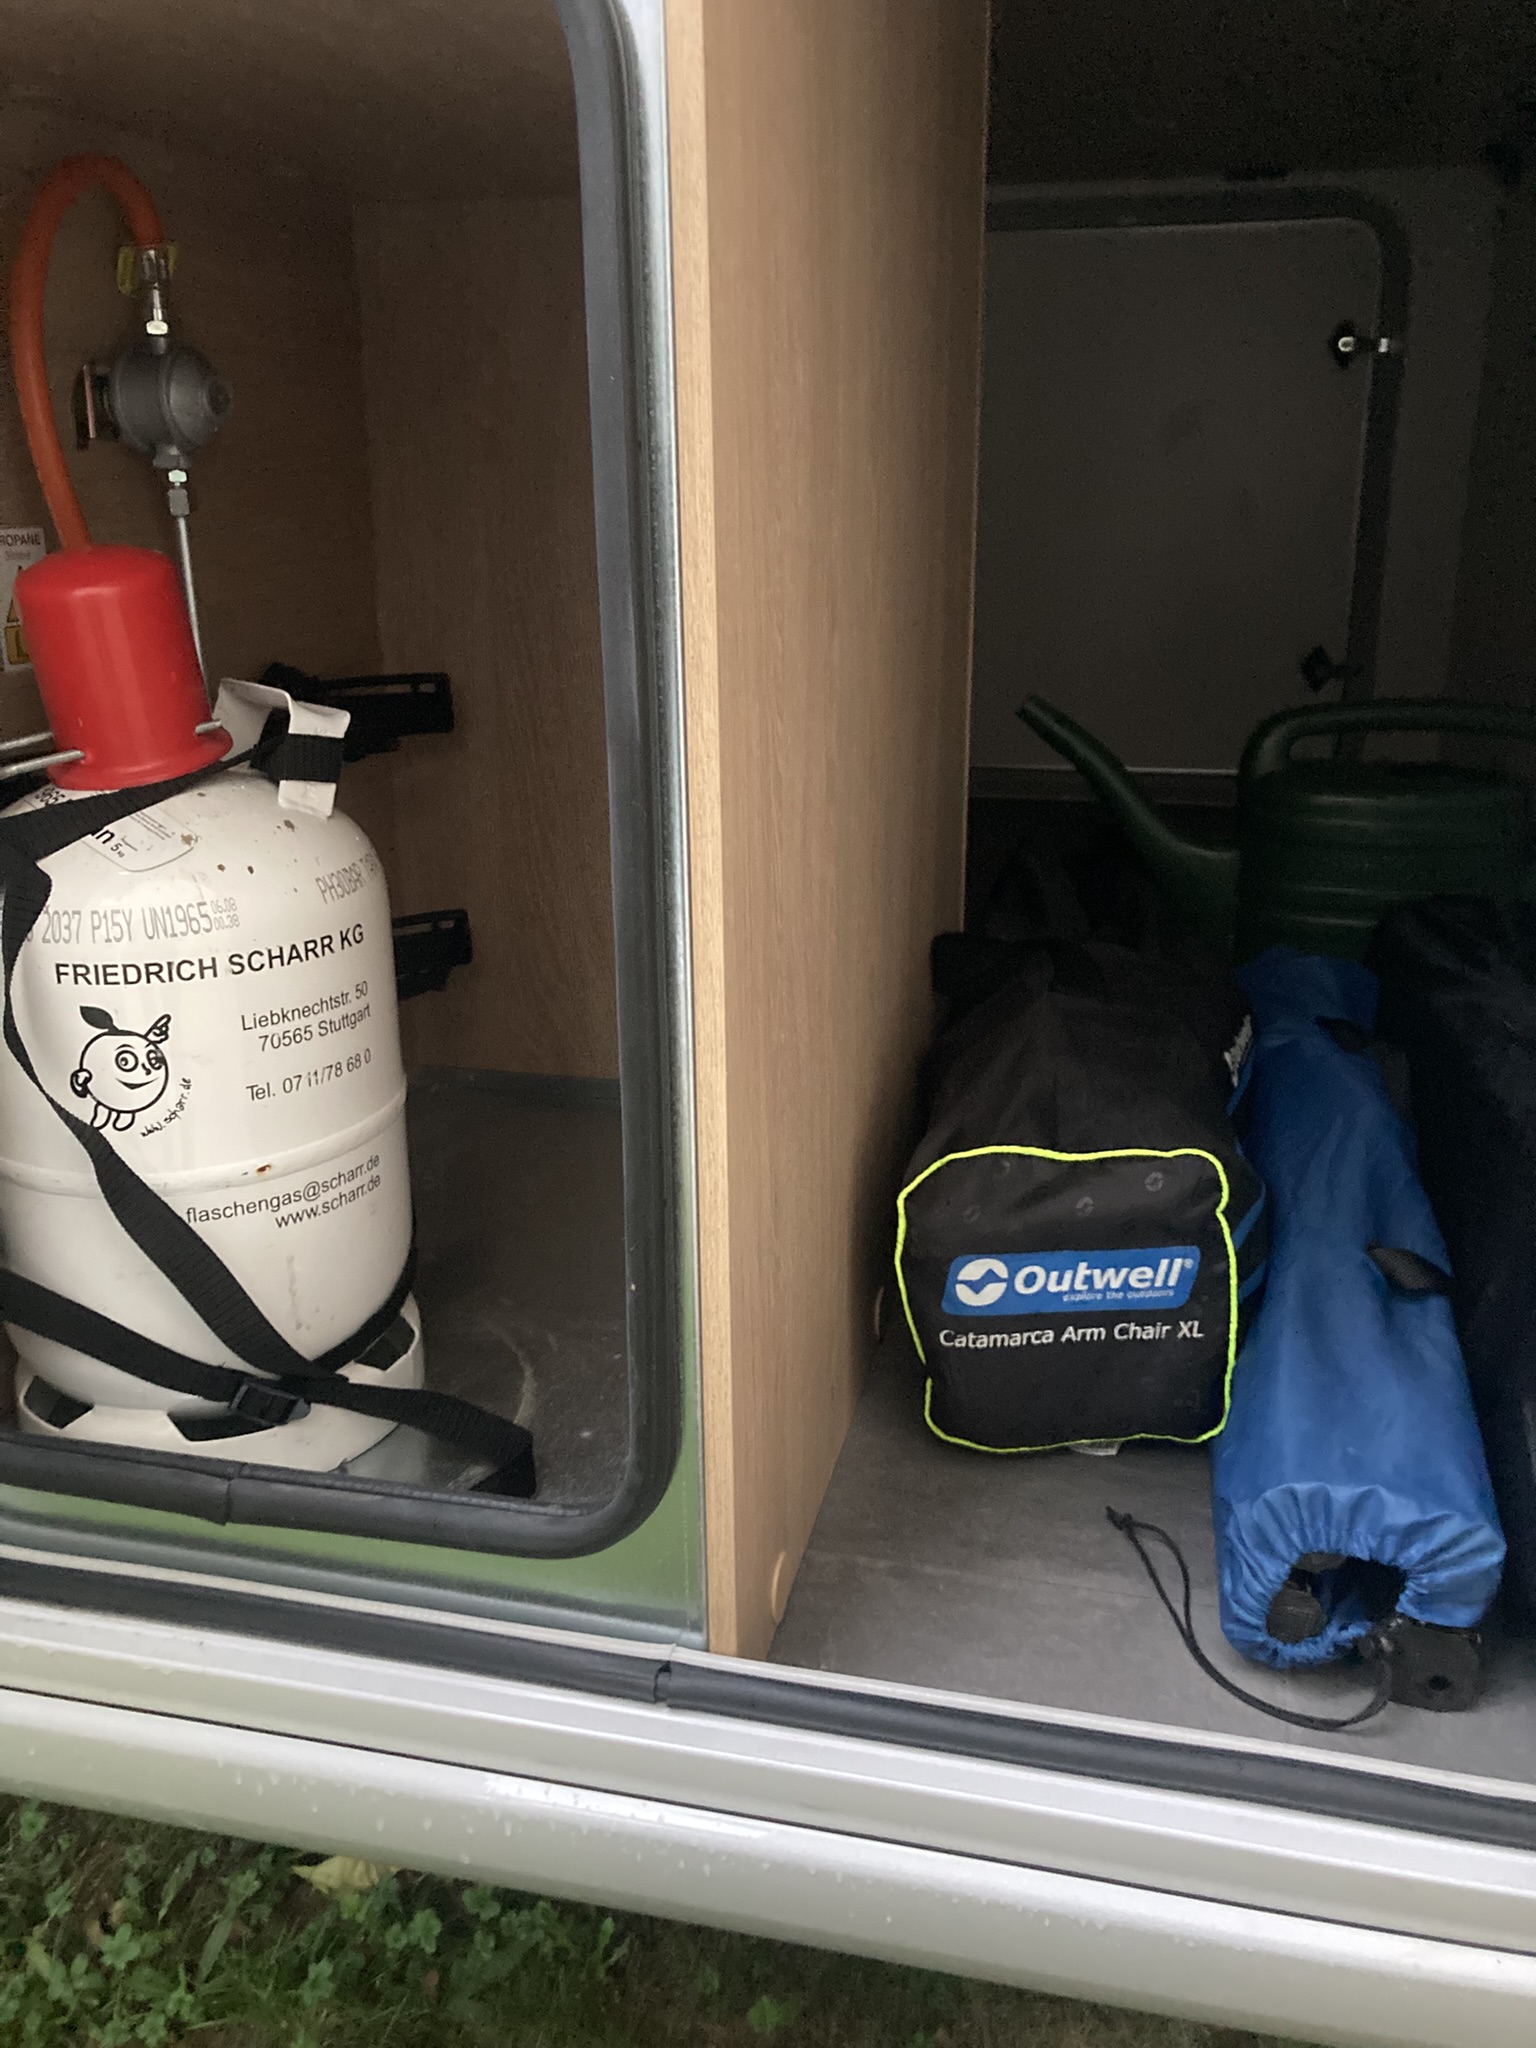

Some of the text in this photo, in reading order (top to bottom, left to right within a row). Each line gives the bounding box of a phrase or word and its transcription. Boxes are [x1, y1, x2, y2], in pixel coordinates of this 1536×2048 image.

[0, 533, 41, 546] ROPANE
[41, 901, 213, 944] 2037 P15Y UN1965
[55, 923, 364, 986] FRIEDRICH SCHARR KG
[241, 980, 368, 1031] Liebknechtstr. 50
[258, 1003, 371, 1052] 70565 Stuttgart
[245, 1082, 276, 1101] Tel.
[186, 1153, 380, 1224] flaschengas@scharr.de
[275, 1173, 382, 1229] www.scharr.de
[1013, 1258, 1183, 1295] Outwell
[1062, 1288, 1175, 1303] explore the outdoors
[939, 1320, 1205, 1349] Catamarca Arm Chair XL
